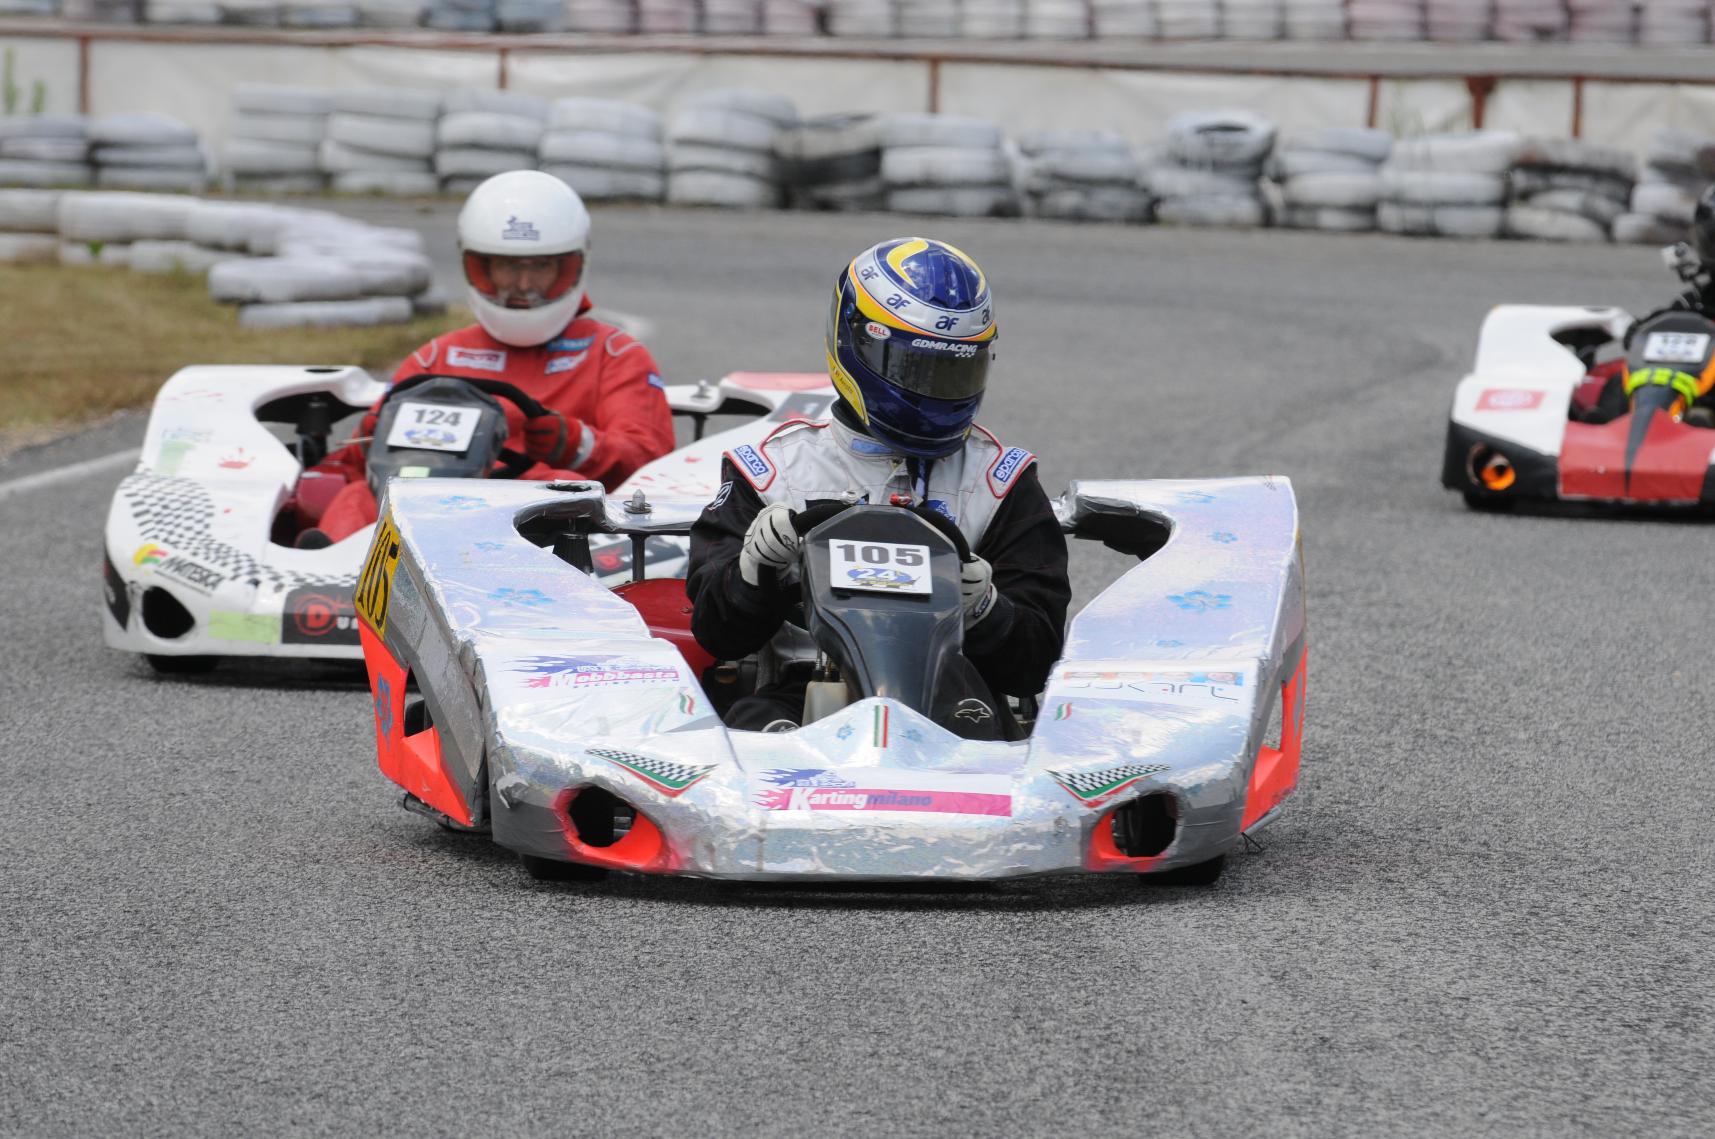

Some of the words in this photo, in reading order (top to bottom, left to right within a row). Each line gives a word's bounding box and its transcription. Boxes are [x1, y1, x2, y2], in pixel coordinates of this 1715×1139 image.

[861, 266, 879, 281] af
[887, 293, 912, 310] af
[868, 324, 888, 336] BELL
[935, 315, 960, 331] af
[414, 408, 462, 426] 124
[738, 445, 766, 474] sparco
[836, 543, 924, 567] 105
[856, 567, 898, 581] 24
